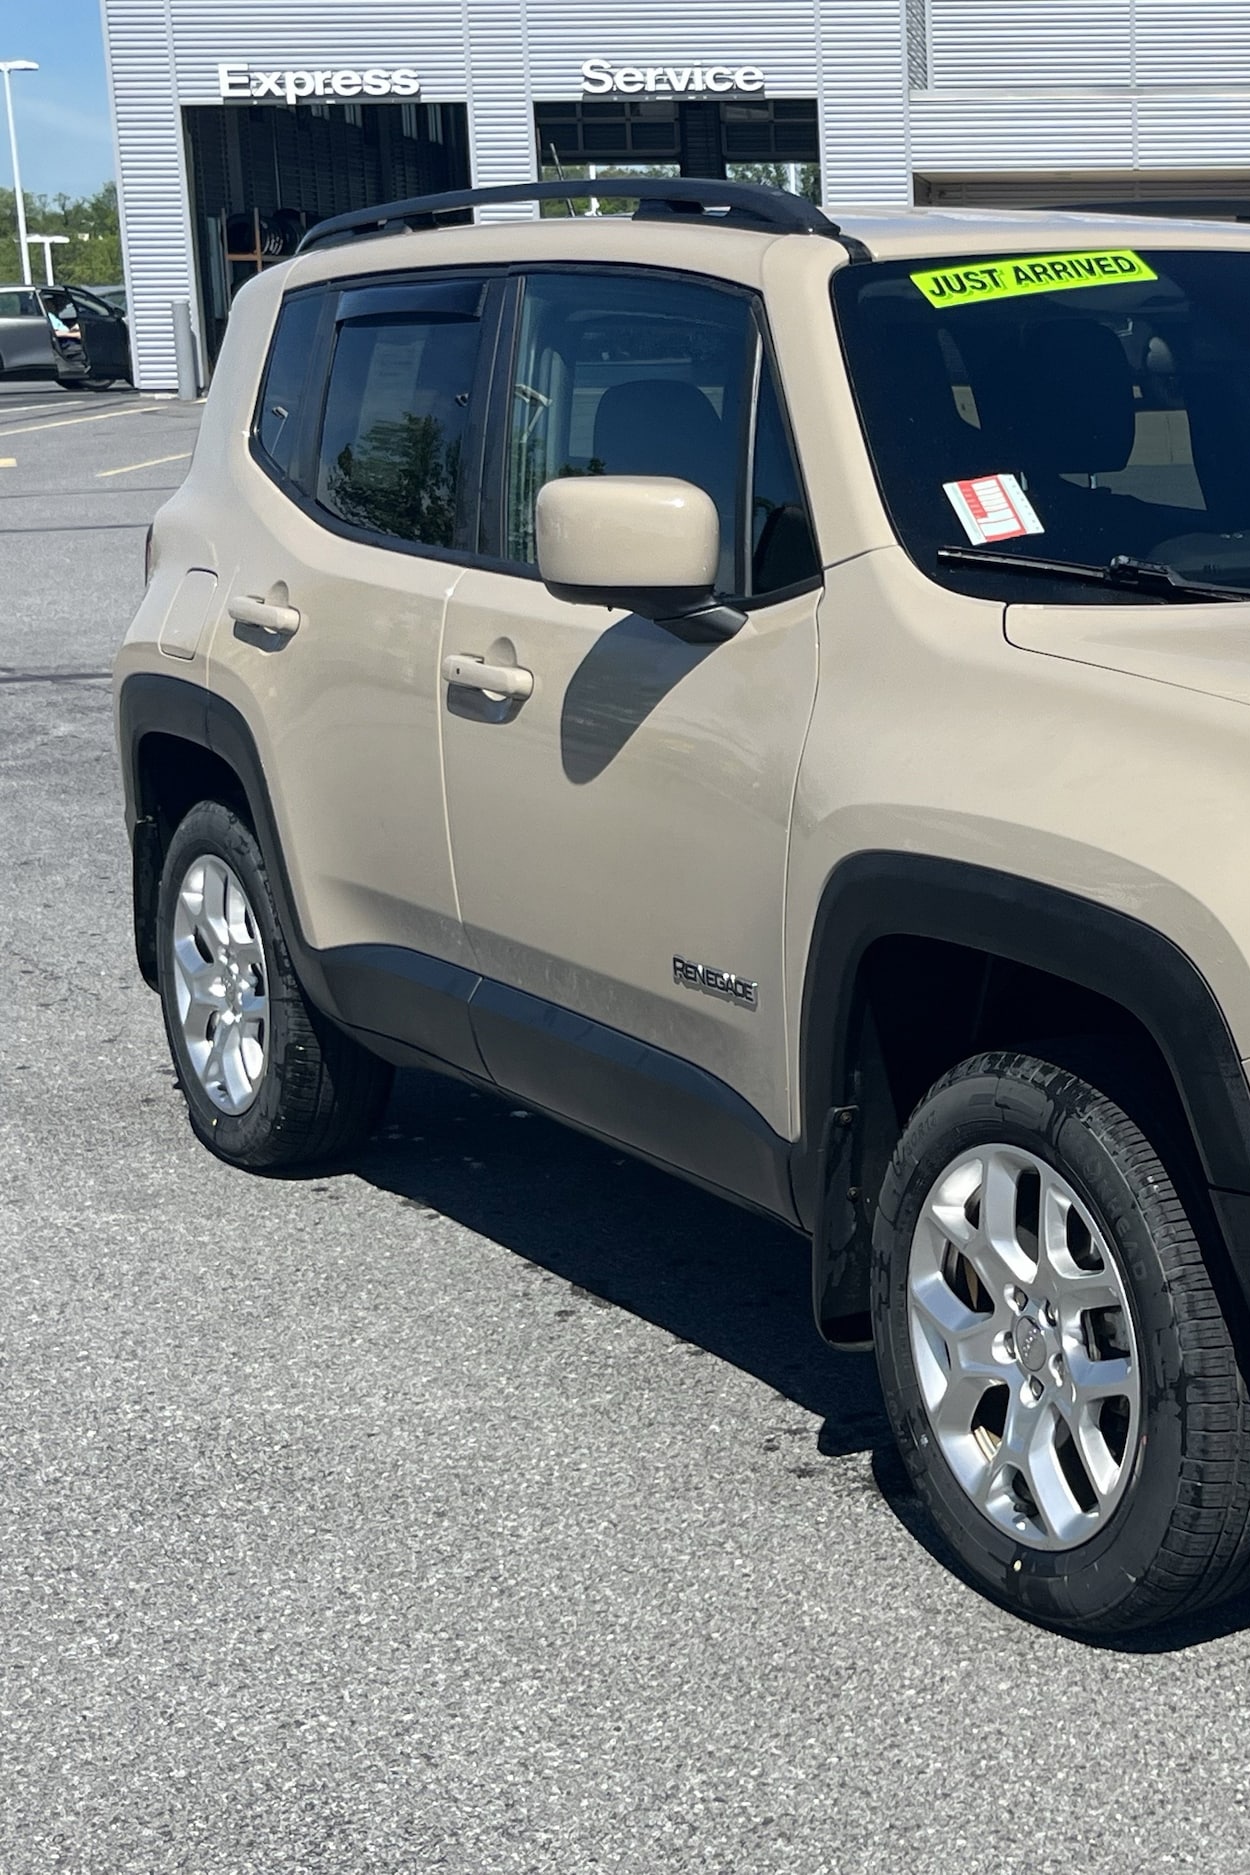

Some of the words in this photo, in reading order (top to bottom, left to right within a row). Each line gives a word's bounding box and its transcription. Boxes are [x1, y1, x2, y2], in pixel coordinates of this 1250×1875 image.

[218, 63, 420, 104] Express
[581, 58, 766, 94] Service
[929, 268, 1002, 297] JUST
[1012, 255, 1137, 286] ARRIVED
[672, 954, 758, 1005] RENEGADE
